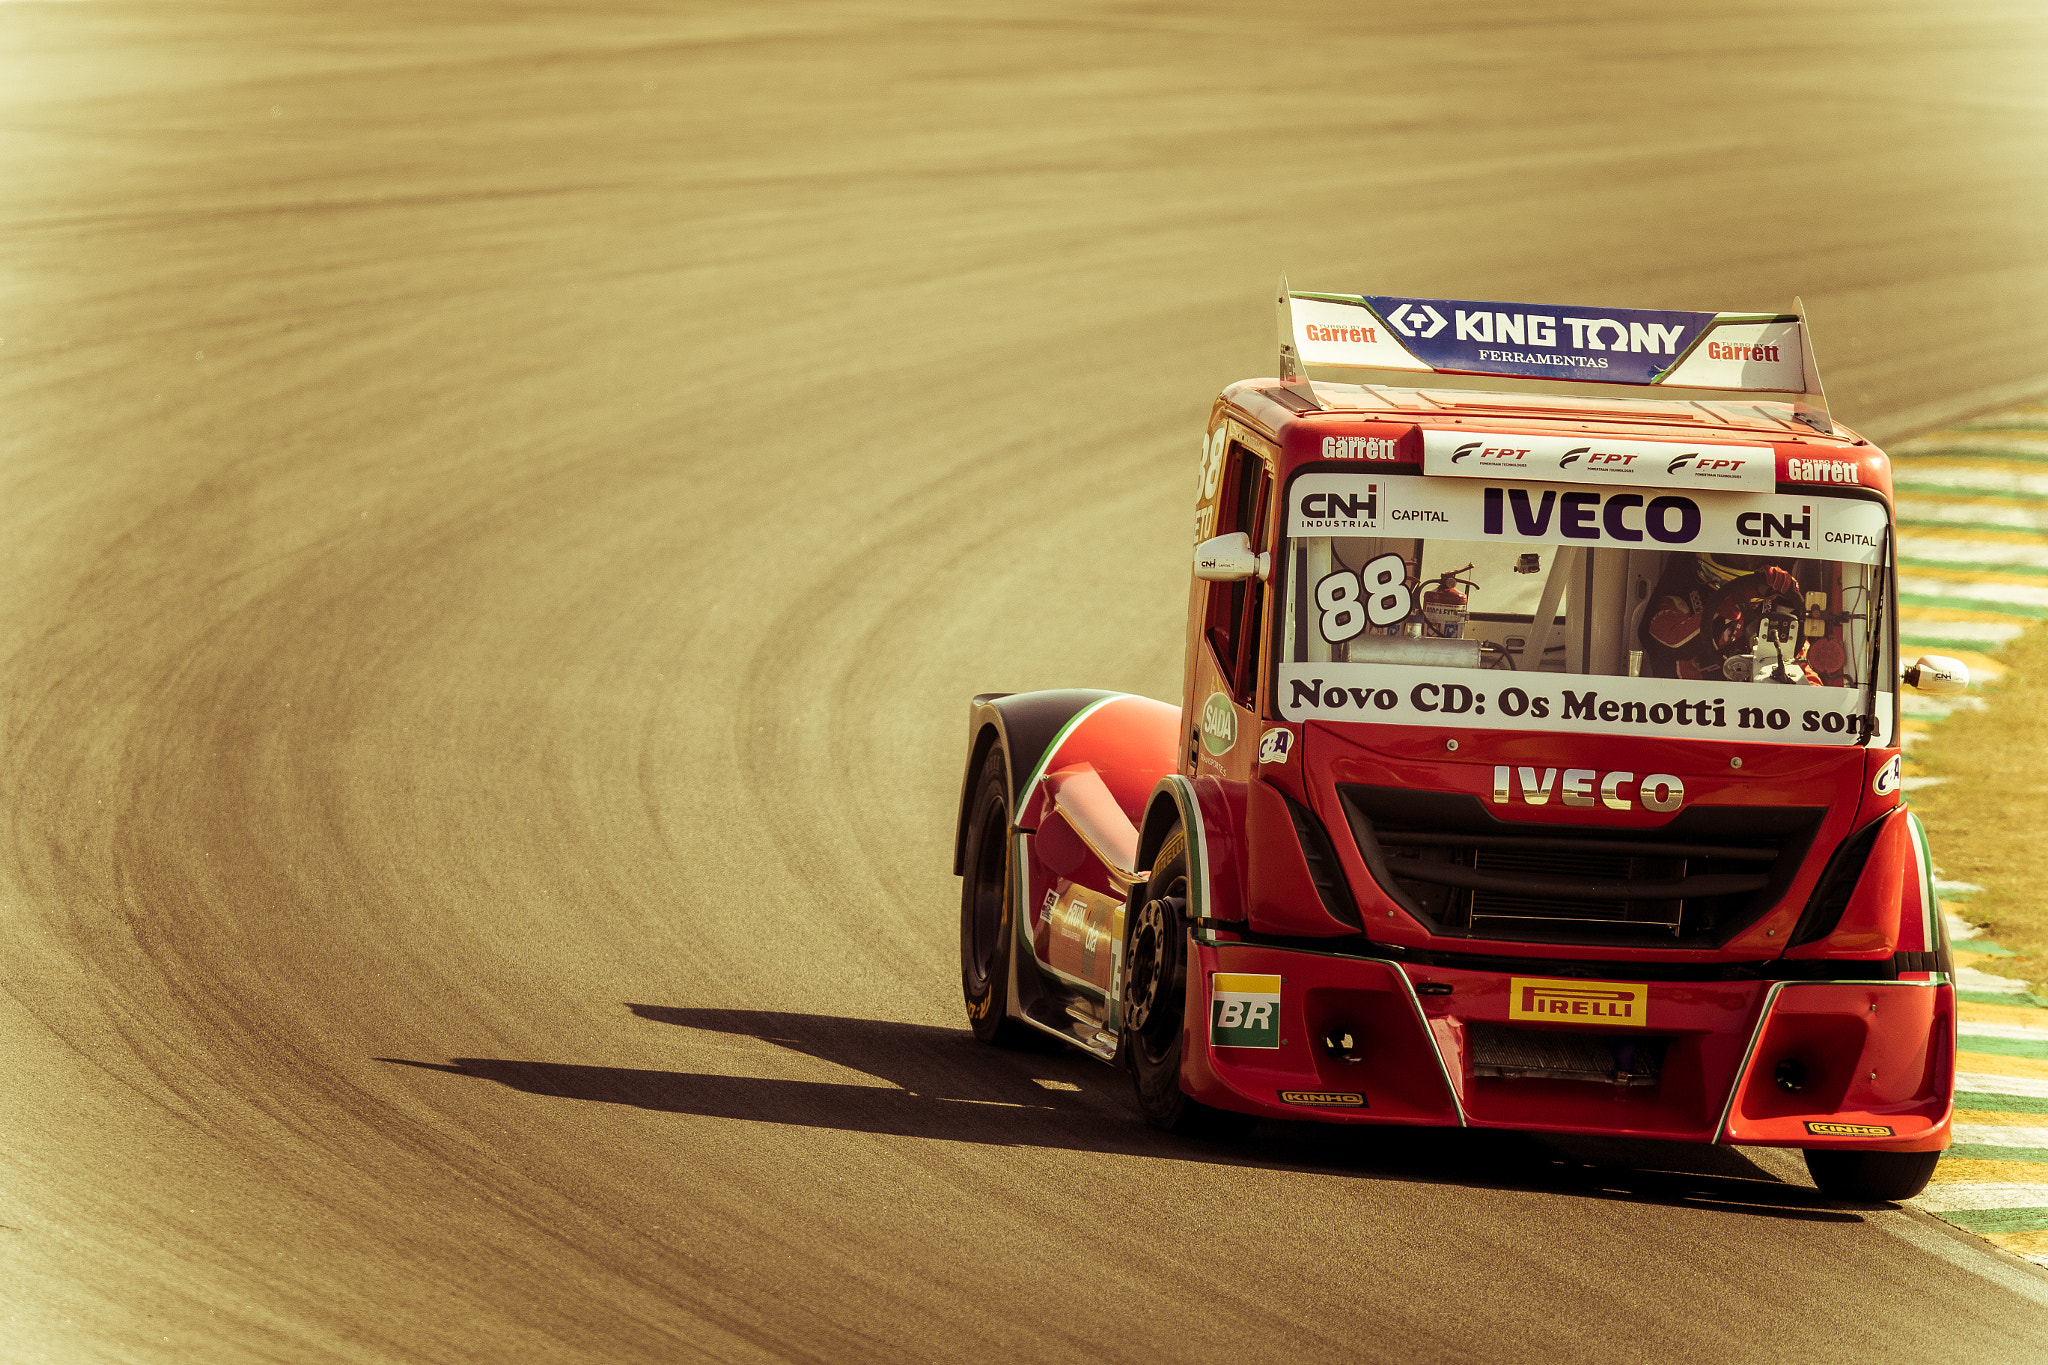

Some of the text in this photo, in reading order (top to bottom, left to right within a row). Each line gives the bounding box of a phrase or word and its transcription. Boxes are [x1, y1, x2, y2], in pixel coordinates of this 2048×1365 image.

[1306, 324, 1377, 343] Garrett
[1455, 309, 1686, 355] KING TONY
[1478, 349, 1609, 369] FERRAMENTAS
[1708, 341, 1780, 362] Garrett
[1322, 436, 1395, 460] Garrett
[1481, 448, 1531, 460] FPT
[1588, 453, 1638, 466] FPT
[1696, 459, 1746, 471] FPT
[1788, 458, 1859, 483] Garrett
[1301, 520, 1377, 528] INDUSTRIAL
[1391, 509, 1449, 523] CAPITAL
[1484, 487, 1701, 544] IVECO
[1737, 538, 1811, 549] INDUSTRIAL
[1824, 531, 1877, 547] CAPITAL
[1315, 552, 1412, 645] 88
[1289, 678, 1881, 737] Novo CD: Os Menotti no som
[1204, 705, 1232, 741] SADA
[1493, 765, 1684, 813] IVECO
[1521, 986, 1635, 1018] PIRELLI
[1217, 1000, 1273, 1030] BR
[1287, 1093, 1360, 1102] KINHO
[1813, 1124, 1885, 1134] KINHO
